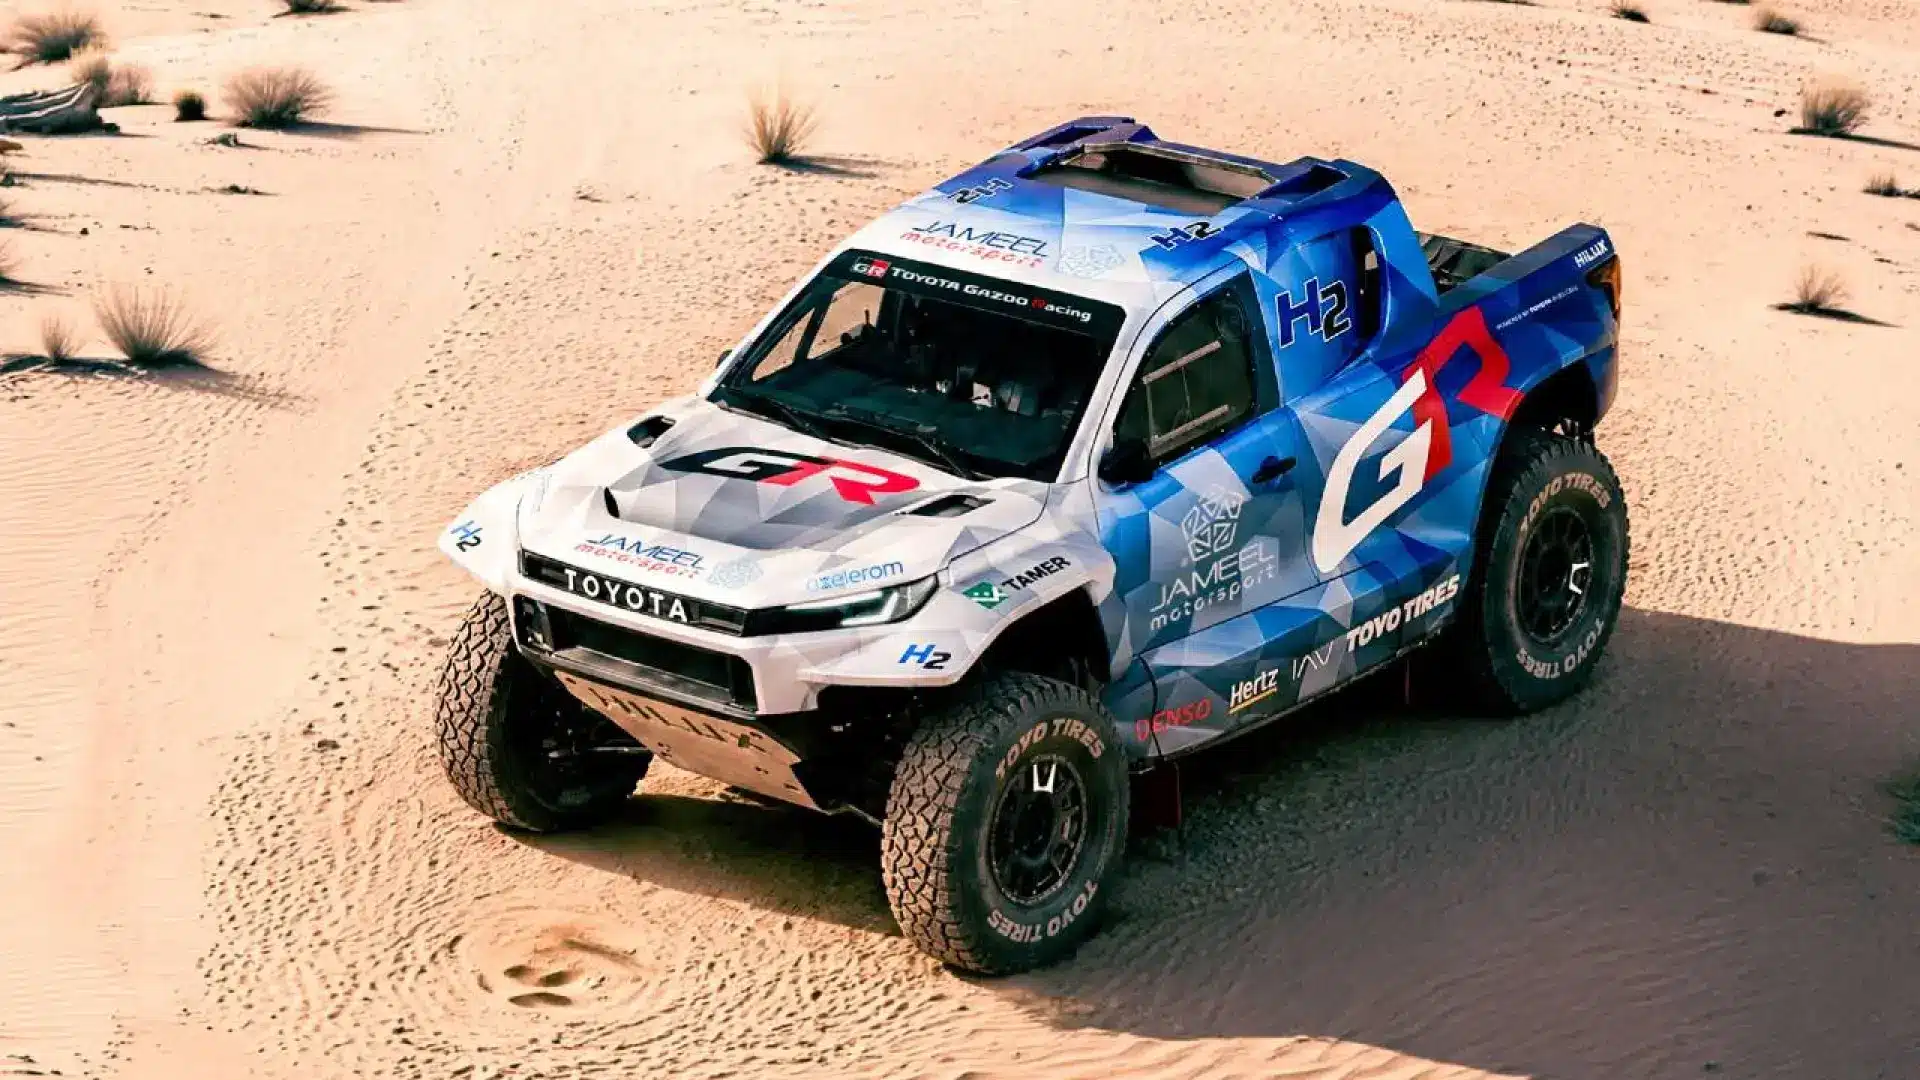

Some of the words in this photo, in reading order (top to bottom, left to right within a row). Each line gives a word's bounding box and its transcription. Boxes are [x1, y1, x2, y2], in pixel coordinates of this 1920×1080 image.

[901, 230, 1043, 269] motorsport
[912, 219, 1050, 258] JAMEEL
[1149, 220, 1226, 251] H2
[1574, 239, 1608, 268] HILUX
[853, 257, 889, 279] GR
[892, 268, 960, 293] TOYOTA
[964, 284, 1029, 306] GAZOO
[1031, 297, 1093, 323] Racing
[1275, 276, 1352, 350] H2
[1311, 304, 1525, 575] GR
[656, 446, 920, 506] GR
[1520, 475, 1563, 533] TOYO
[1562, 472, 1611, 510] TIRES
[450, 519, 484, 552] H2
[585, 533, 706, 572] JAMEEL
[573, 543, 701, 580] motorsport
[1001, 556, 1072, 591] TAMER
[1149, 541, 1277, 615] JAMEEL
[563, 569, 688, 623] TOYOTA
[1150, 563, 1278, 632] motorsport
[1346, 601, 1401, 653] TOYO
[1403, 574, 1461, 624] TIRES
[898, 643, 953, 671] H2
[1515, 648, 1561, 679] TIRES
[1564, 617, 1604, 673] TOYO
[1229, 667, 1280, 708] Hertz
[1136, 699, 1212, 742] DENSO
[995, 722, 1048, 779] TOYO
[1051, 718, 1105, 760] TIRES
[986, 908, 1044, 943] TIRES
[1046, 879, 1099, 938] TOYO
